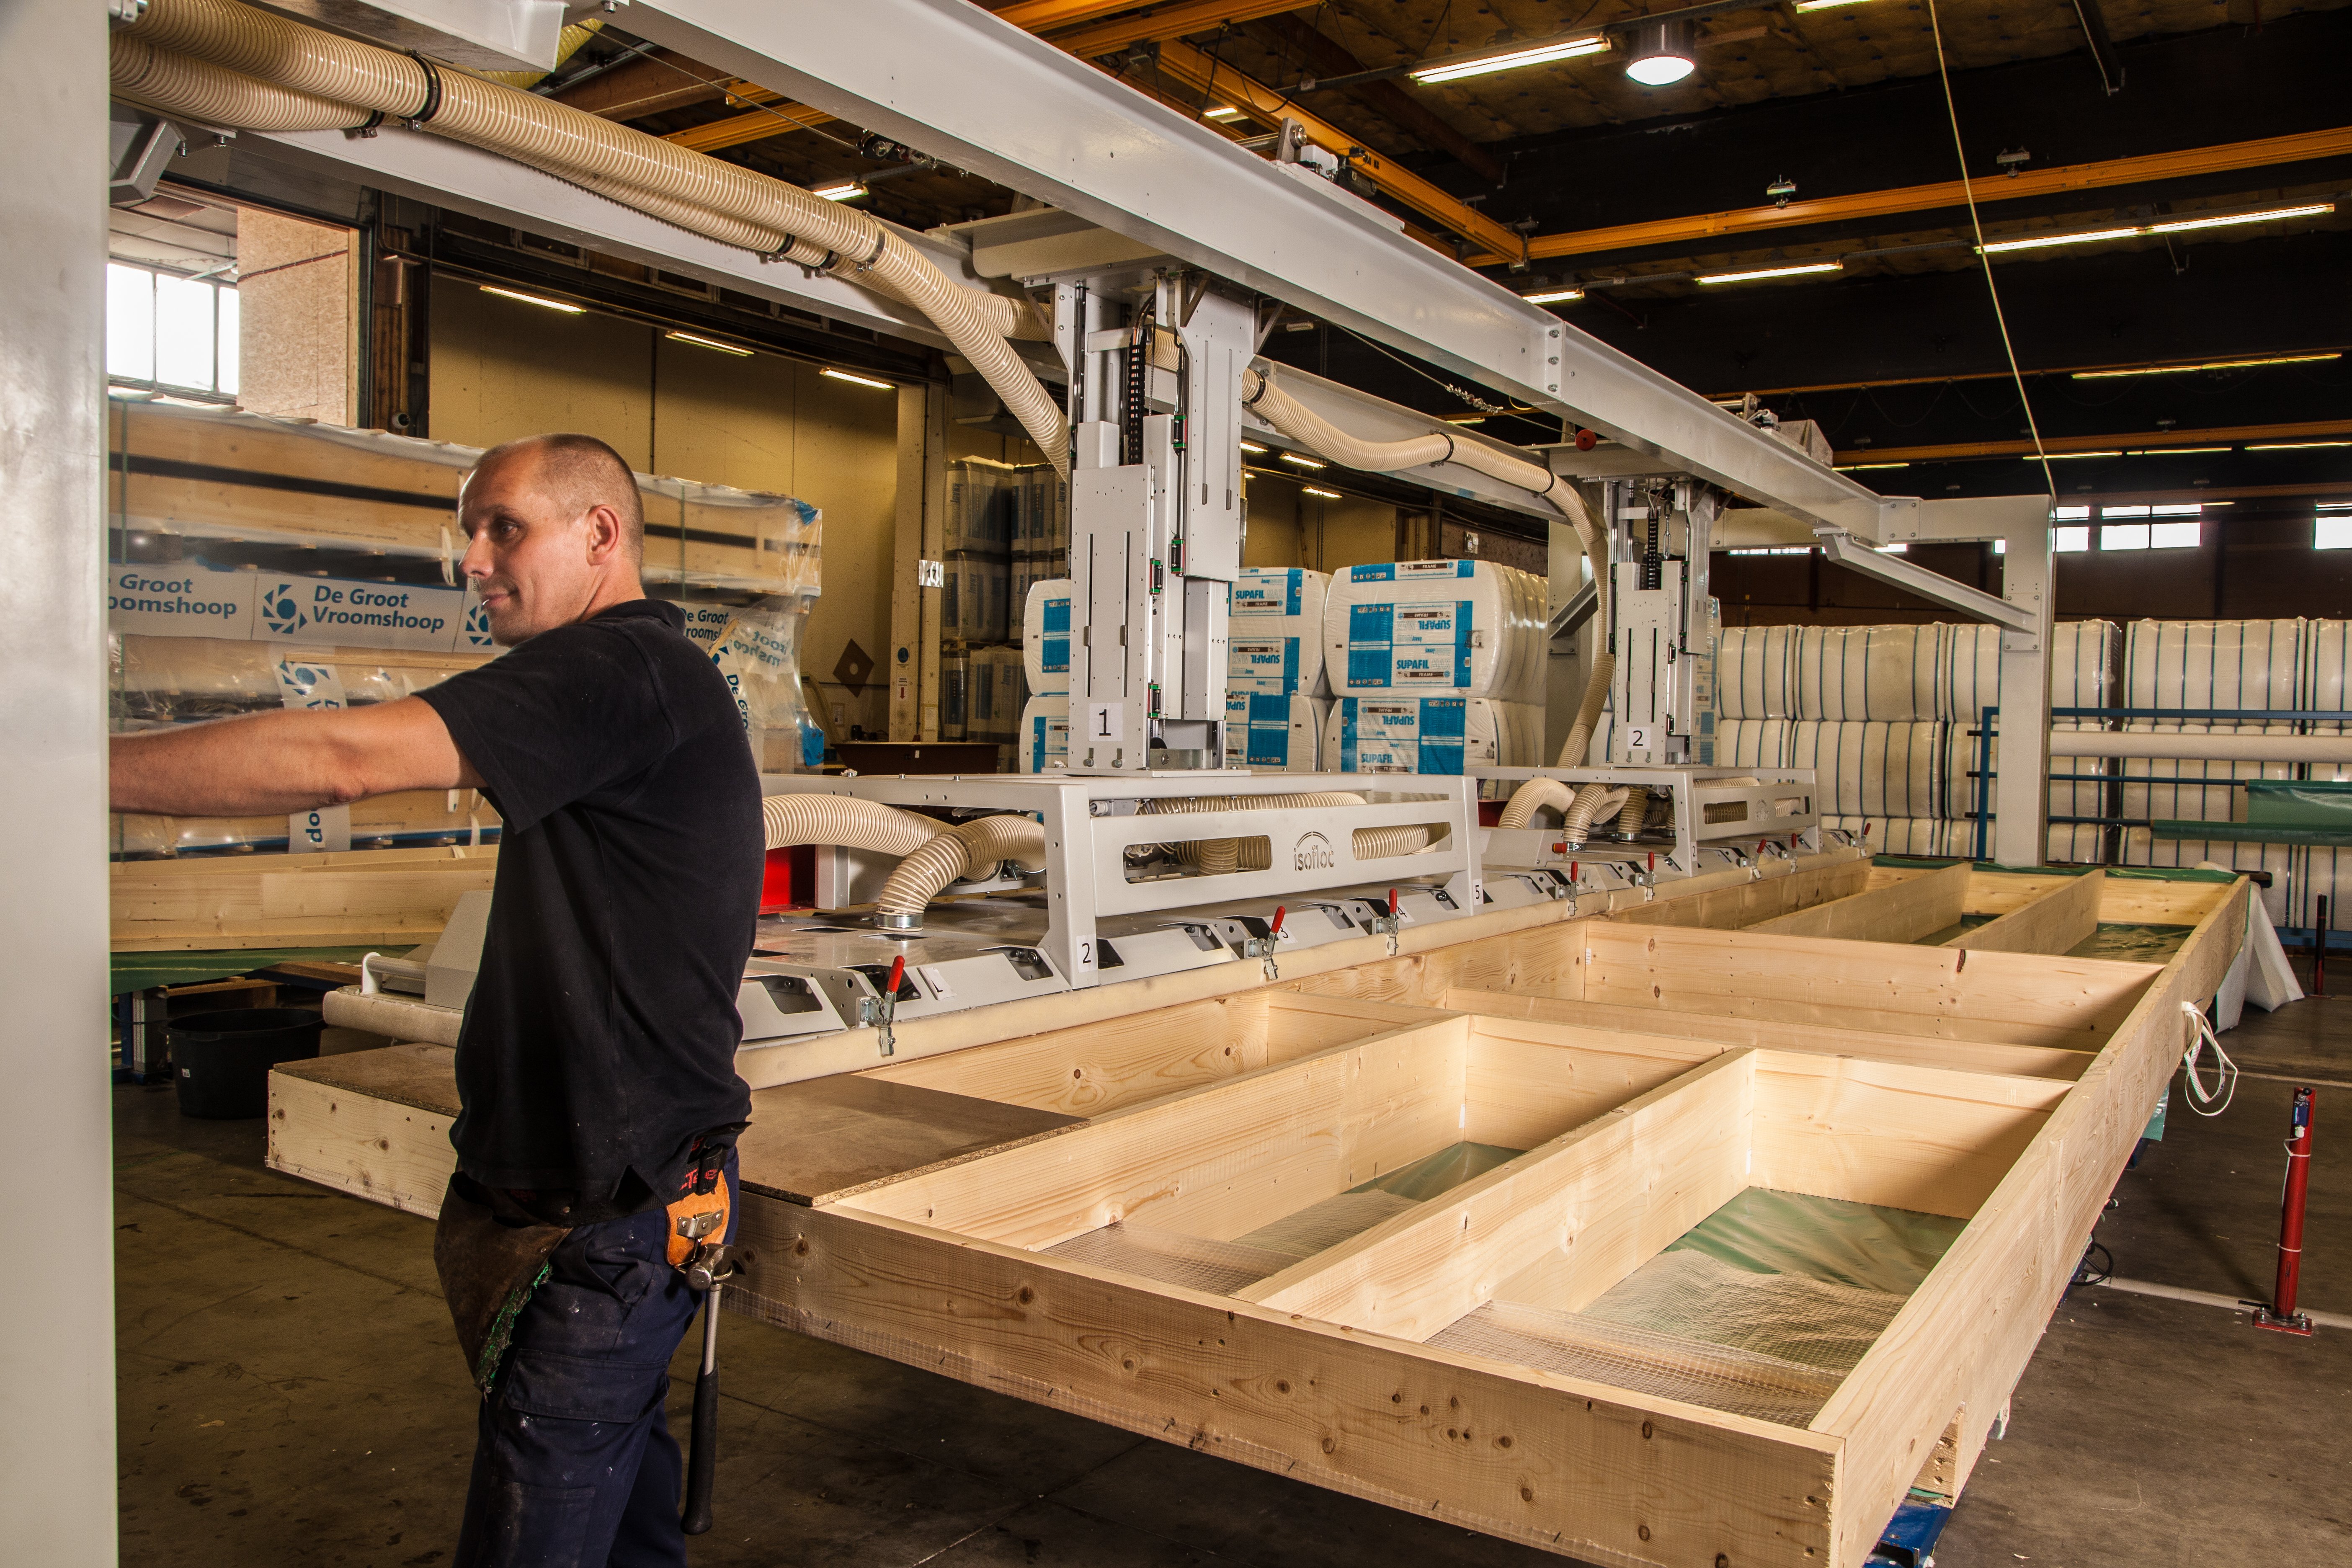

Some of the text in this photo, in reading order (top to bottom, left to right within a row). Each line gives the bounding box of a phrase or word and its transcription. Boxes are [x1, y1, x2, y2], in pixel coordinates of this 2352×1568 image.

[119, 574, 193, 593] Groot
[314, 585, 409, 608] De Groot
[1235, 589, 1284, 599] SUPAFIL MAX
[108, 596, 237, 619] oomshoop
[313, 606, 444, 634] Vroomshoop
[697, 609, 729, 624] Groot
[1418, 620, 1451, 630] SUPAFIL
[1231, 655, 1280, 664] SUPAFIL MAX
[1396, 659, 1429, 669] SUPAFIL
[726, 674, 739, 695] De
[1227, 701, 1246, 710] SUPA
[1099, 709, 1111, 736] 1
[1382, 715, 1415, 725] SUPAFIL
[1632, 730, 1643, 746] 2
[1361, 753, 1394, 763] SUPAFIL
[1294, 844, 1334, 871] isofloc
[1692, 846, 1696, 857] 2
[1475, 885, 1480, 899] 5
[1397, 906, 1407, 918] 4
[1082, 942, 1091, 964] 2
